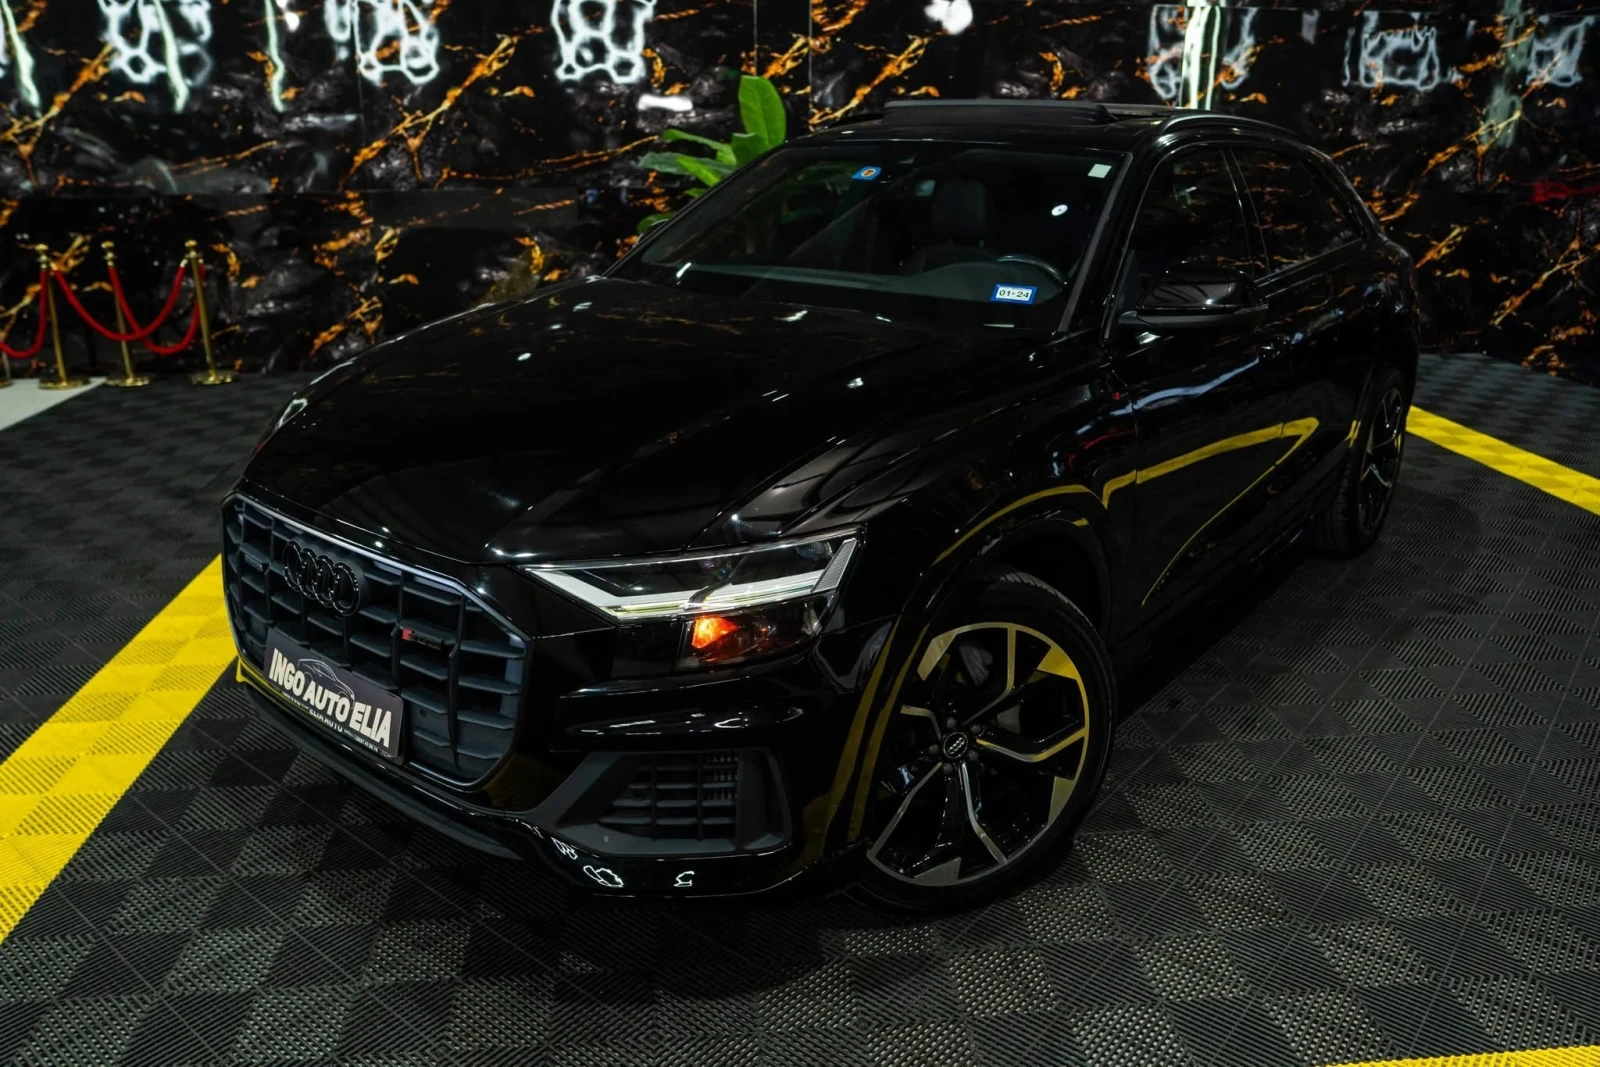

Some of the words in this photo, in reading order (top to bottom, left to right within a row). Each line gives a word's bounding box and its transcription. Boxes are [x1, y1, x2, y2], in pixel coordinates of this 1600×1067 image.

[269, 648, 305, 697] INGO
[303, 680, 351, 723] AUTO
[349, 701, 392, 749] ELIA
